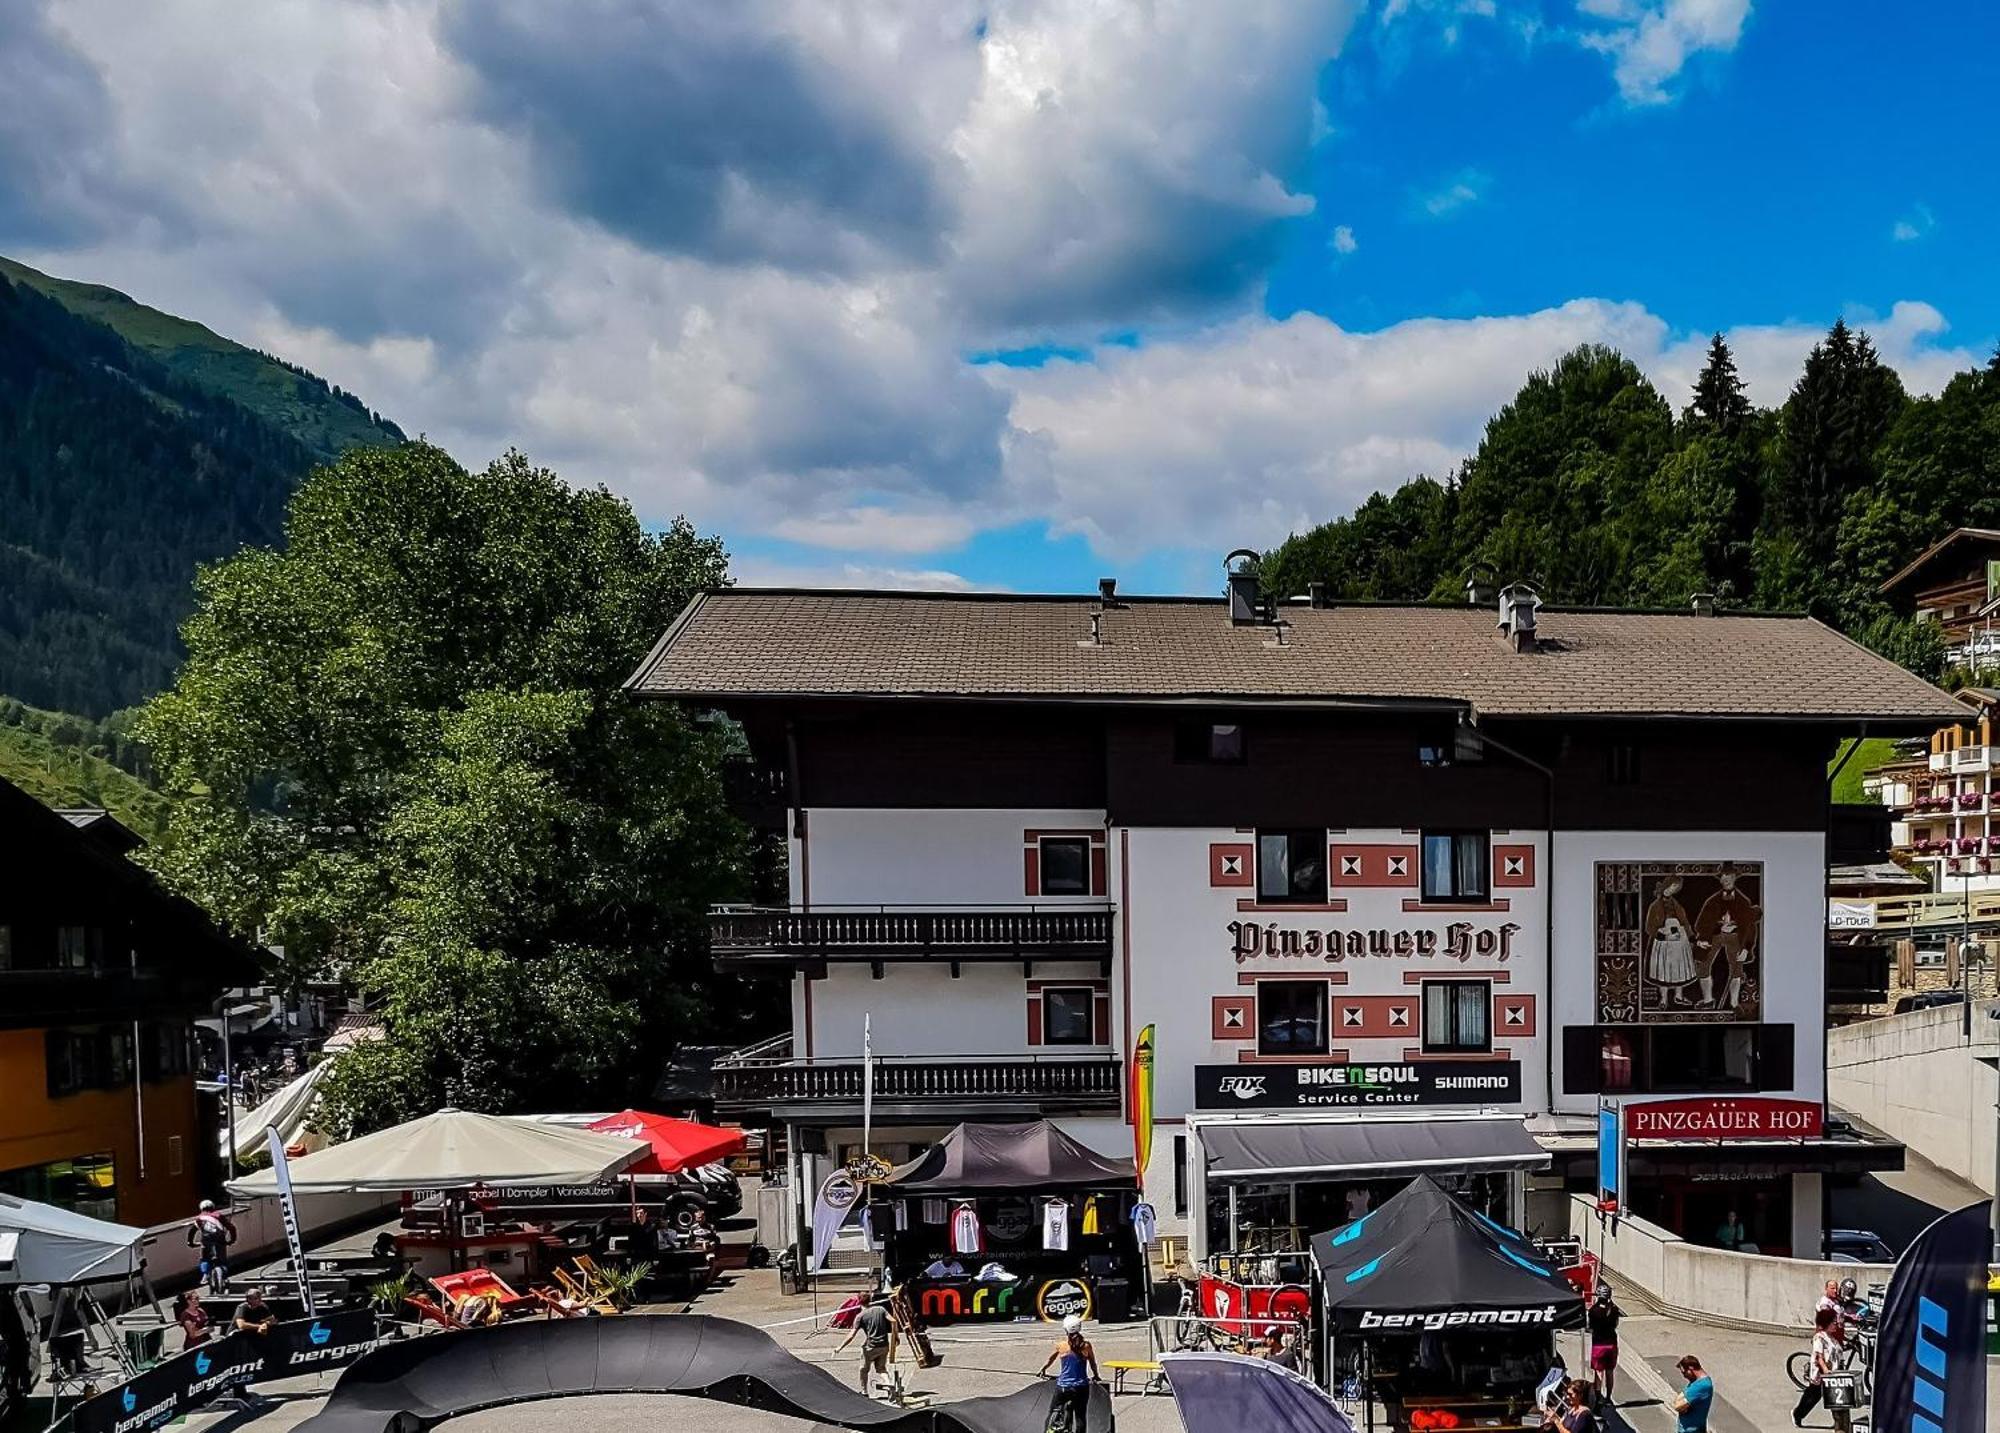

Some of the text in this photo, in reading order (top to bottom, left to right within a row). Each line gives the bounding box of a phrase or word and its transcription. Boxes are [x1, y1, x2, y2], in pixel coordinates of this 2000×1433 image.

[1227, 921, 1521, 963] Pinzgauer Hof
[1219, 1076, 1264, 1092] FOX
[1435, 1076, 1509, 1089] SHIMANO
[1298, 1092, 1420, 1104] Service Center
[1636, 1111, 1814, 1130] PINZGAUER HOF
[1044, 1298, 1087, 1315] reggae
[1360, 1305, 1557, 1331] bergamont
[1822, 1377, 1854, 1388] TOUR
[1835, 1388, 1844, 1405] 2
[115, 1392, 178, 1433] bergamont
